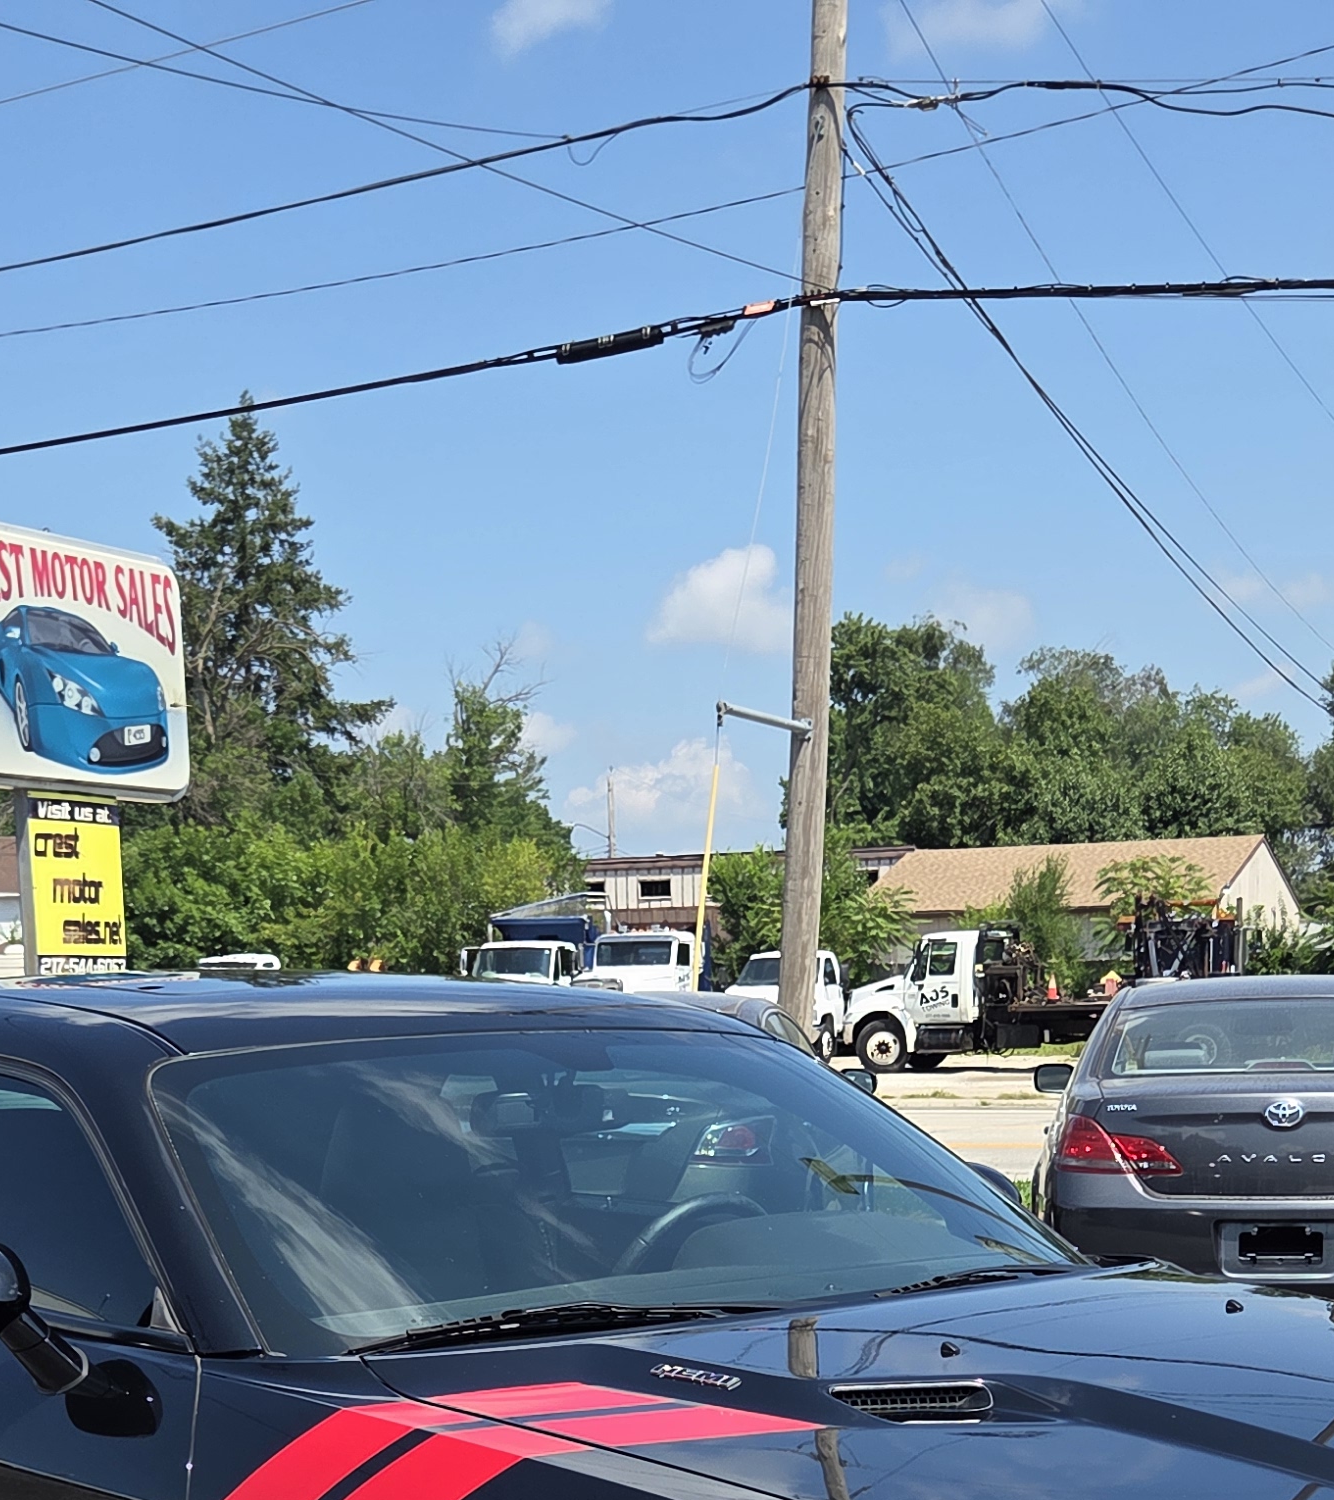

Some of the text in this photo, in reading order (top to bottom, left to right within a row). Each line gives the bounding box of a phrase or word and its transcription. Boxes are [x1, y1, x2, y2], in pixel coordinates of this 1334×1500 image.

[29, 547, 111, 612] MOTOR
[114, 564, 175, 656] SALES
[37, 801, 71, 820] Visit
[74, 806, 93, 822] us
[34, 827, 79, 859] crest
[53, 872, 103, 905] motor
[1107, 1104, 1137, 1112] TOYOTA
